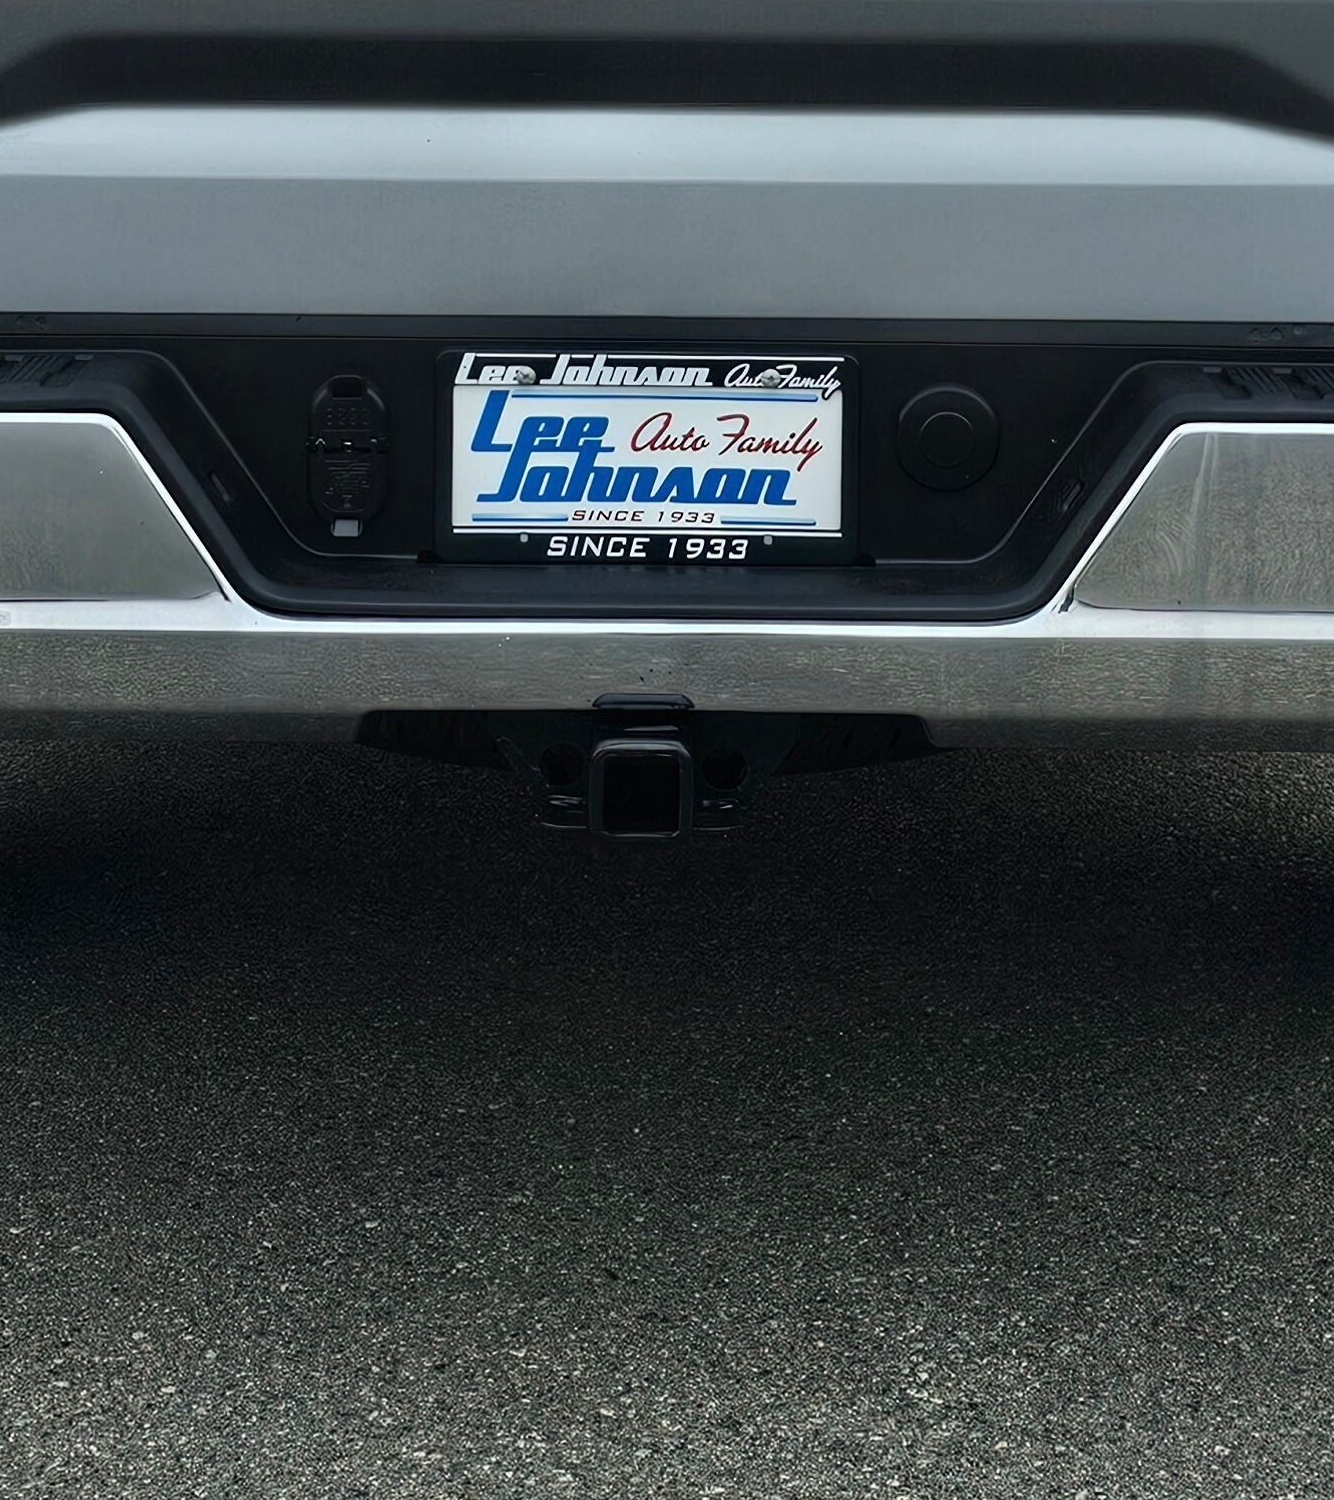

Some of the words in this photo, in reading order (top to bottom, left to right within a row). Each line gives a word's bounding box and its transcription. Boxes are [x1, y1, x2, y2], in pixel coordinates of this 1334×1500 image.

[539, 353, 714, 387] Johnson
[774, 364, 842, 398] Family
[471, 389, 616, 453] Lee
[630, 412, 711, 453] Auto
[716, 413, 823, 473] Family
[476, 445, 798, 506] Johnson
[571, 509, 645, 523] SINCE
[657, 510, 715, 524] 1933
[546, 535, 651, 559] SINCE
[668, 536, 749, 561] 1933
